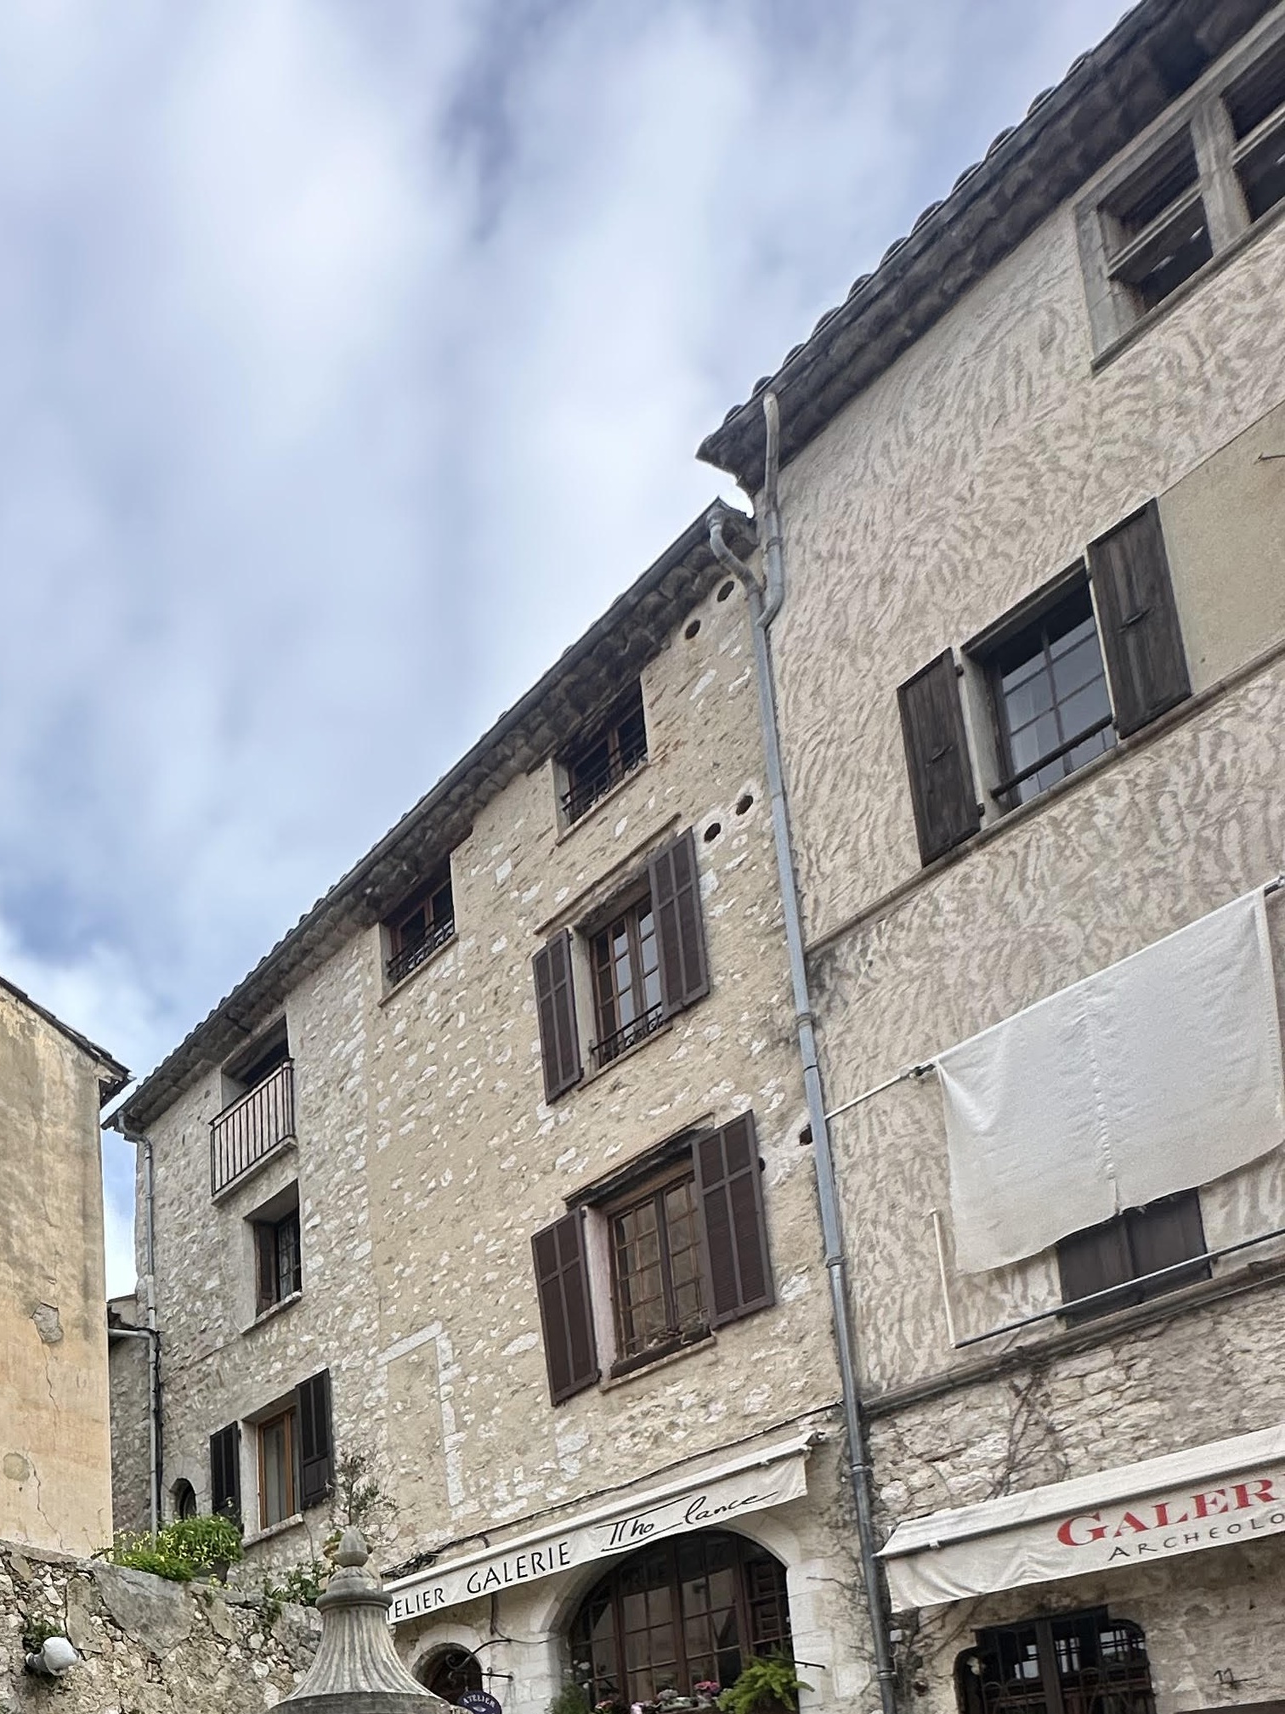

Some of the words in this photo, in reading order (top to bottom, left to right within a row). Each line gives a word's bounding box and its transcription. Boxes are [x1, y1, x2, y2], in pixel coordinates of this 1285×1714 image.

[1057, 1474, 1285, 1547] GALER
[386, 1587, 446, 1621] TELIER
[467, 1541, 571, 1594] GALERIE
[463, 1694, 495, 1708] ATELIER
